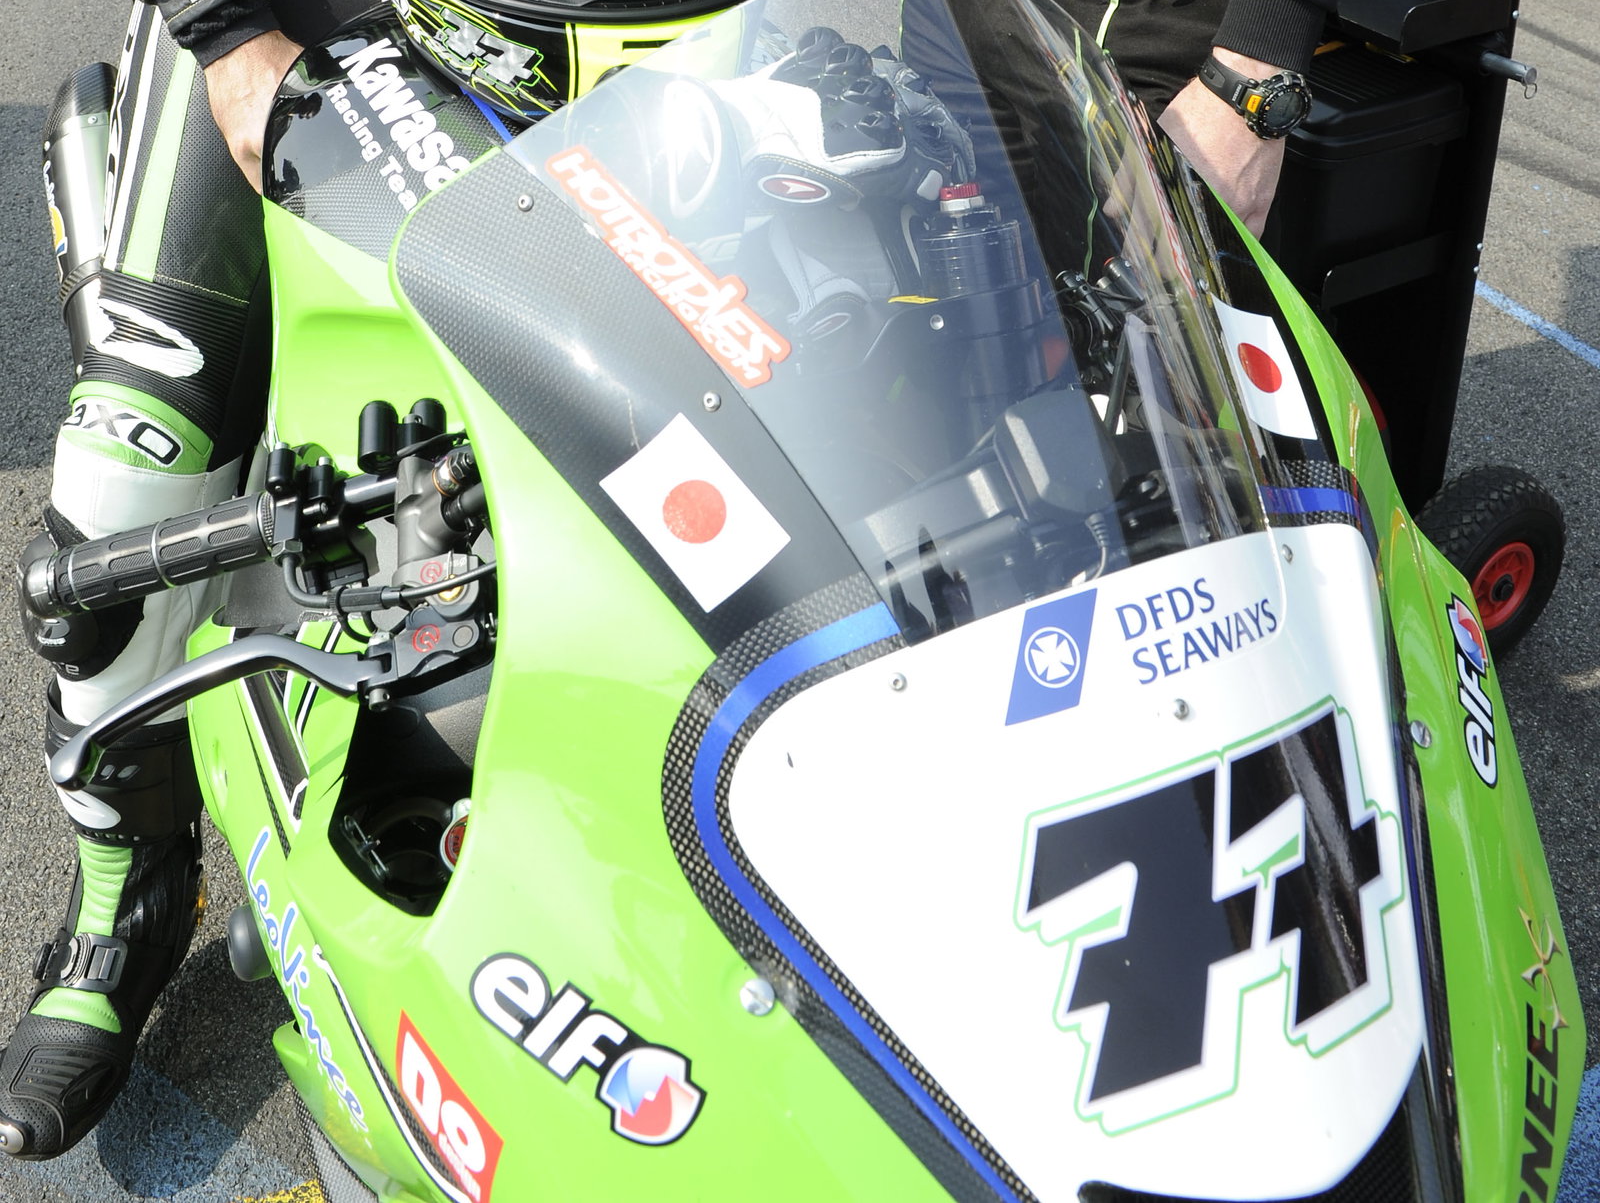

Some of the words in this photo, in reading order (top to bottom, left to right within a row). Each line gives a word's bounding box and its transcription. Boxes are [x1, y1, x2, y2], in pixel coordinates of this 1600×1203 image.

[325, 82, 384, 164] Racing
[379, 154, 418, 213] Tea
[551, 152, 782, 363] HOTBODIES
[1115, 577, 1215, 641] DFDS
[1132, 598, 1278, 685] SEAWAYS
[1456, 652, 1498, 787] elf
[247, 825, 369, 1133] LeoVince
[472, 956, 629, 1080] elf
